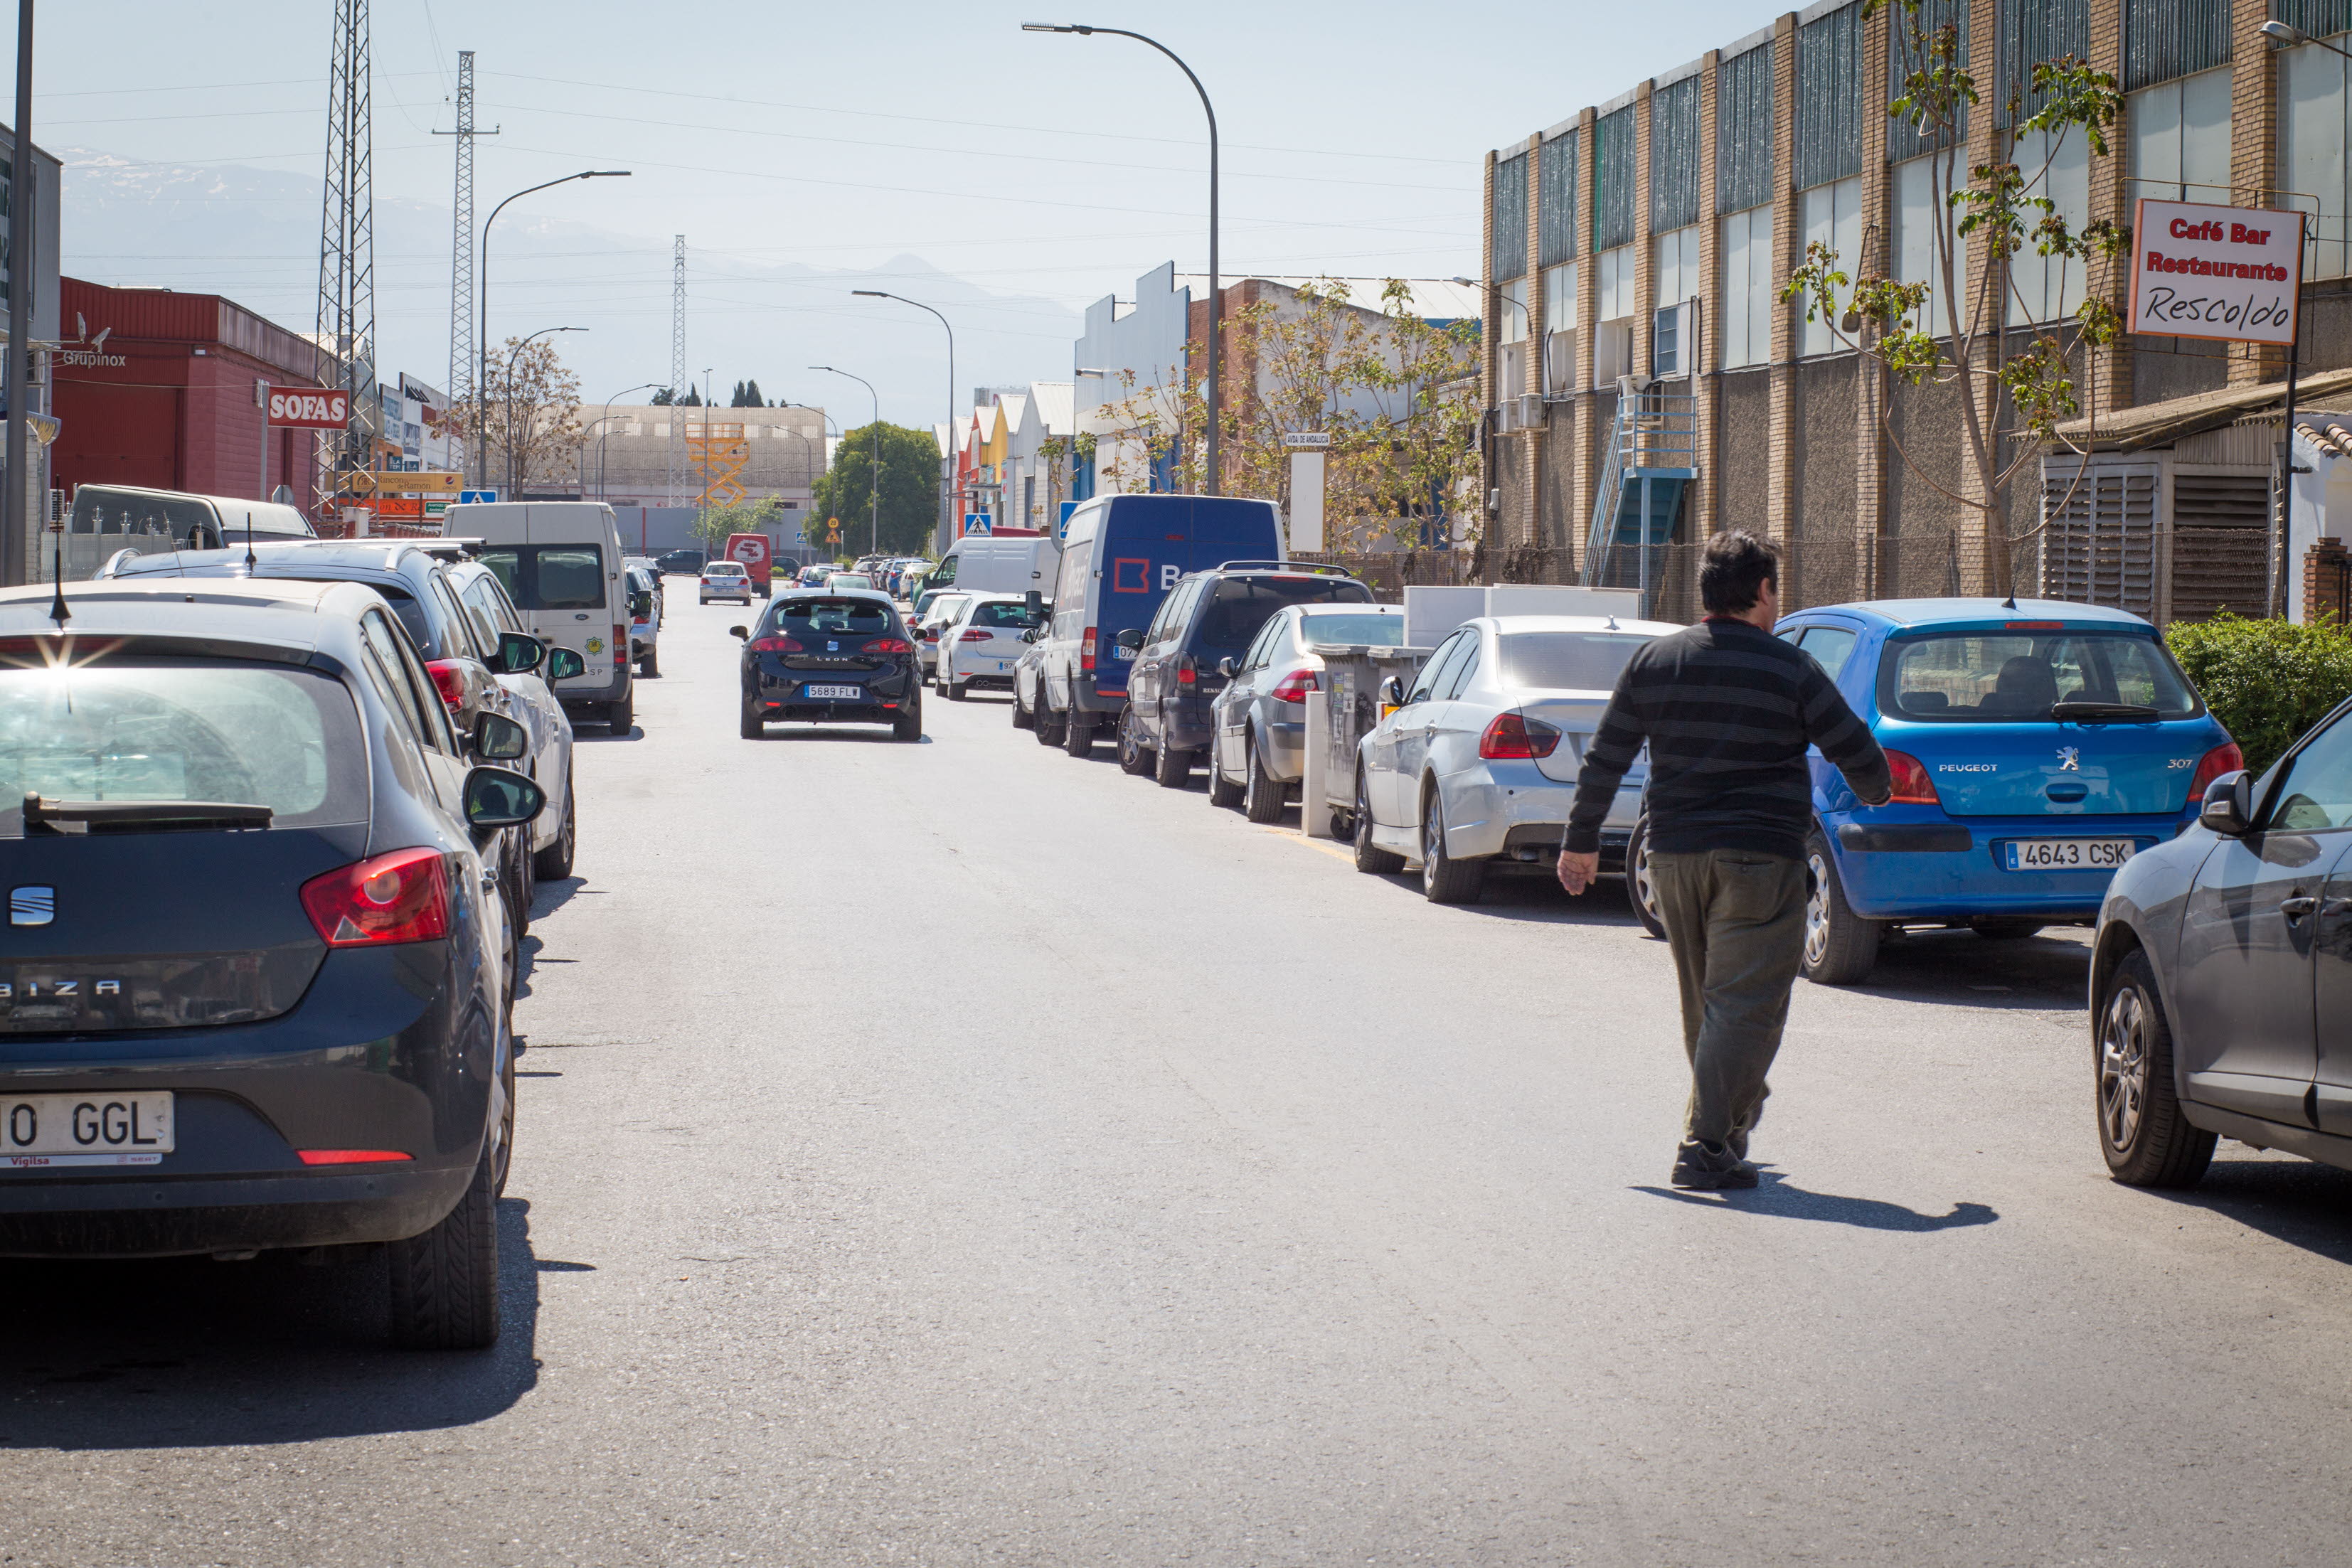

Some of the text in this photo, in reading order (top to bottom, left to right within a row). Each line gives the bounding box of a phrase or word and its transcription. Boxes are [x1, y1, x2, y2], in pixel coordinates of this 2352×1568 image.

[2169, 218, 2271, 245] Café Bar
[2146, 251, 2288, 282] Restaurante
[2145, 287, 2289, 331] Rescoldo
[63, 351, 126, 368] Grupinox
[270, 394, 346, 422] SOFAS
[811, 687, 836, 696] 5689
[1939, 764, 1998, 772] PEUGEOT
[2167, 759, 2193, 769] 307
[2026, 843, 2127, 865] 4643 CSK
[73, 1102, 157, 1145] GGL
[11, 1156, 50, 1167] Vigilsa
